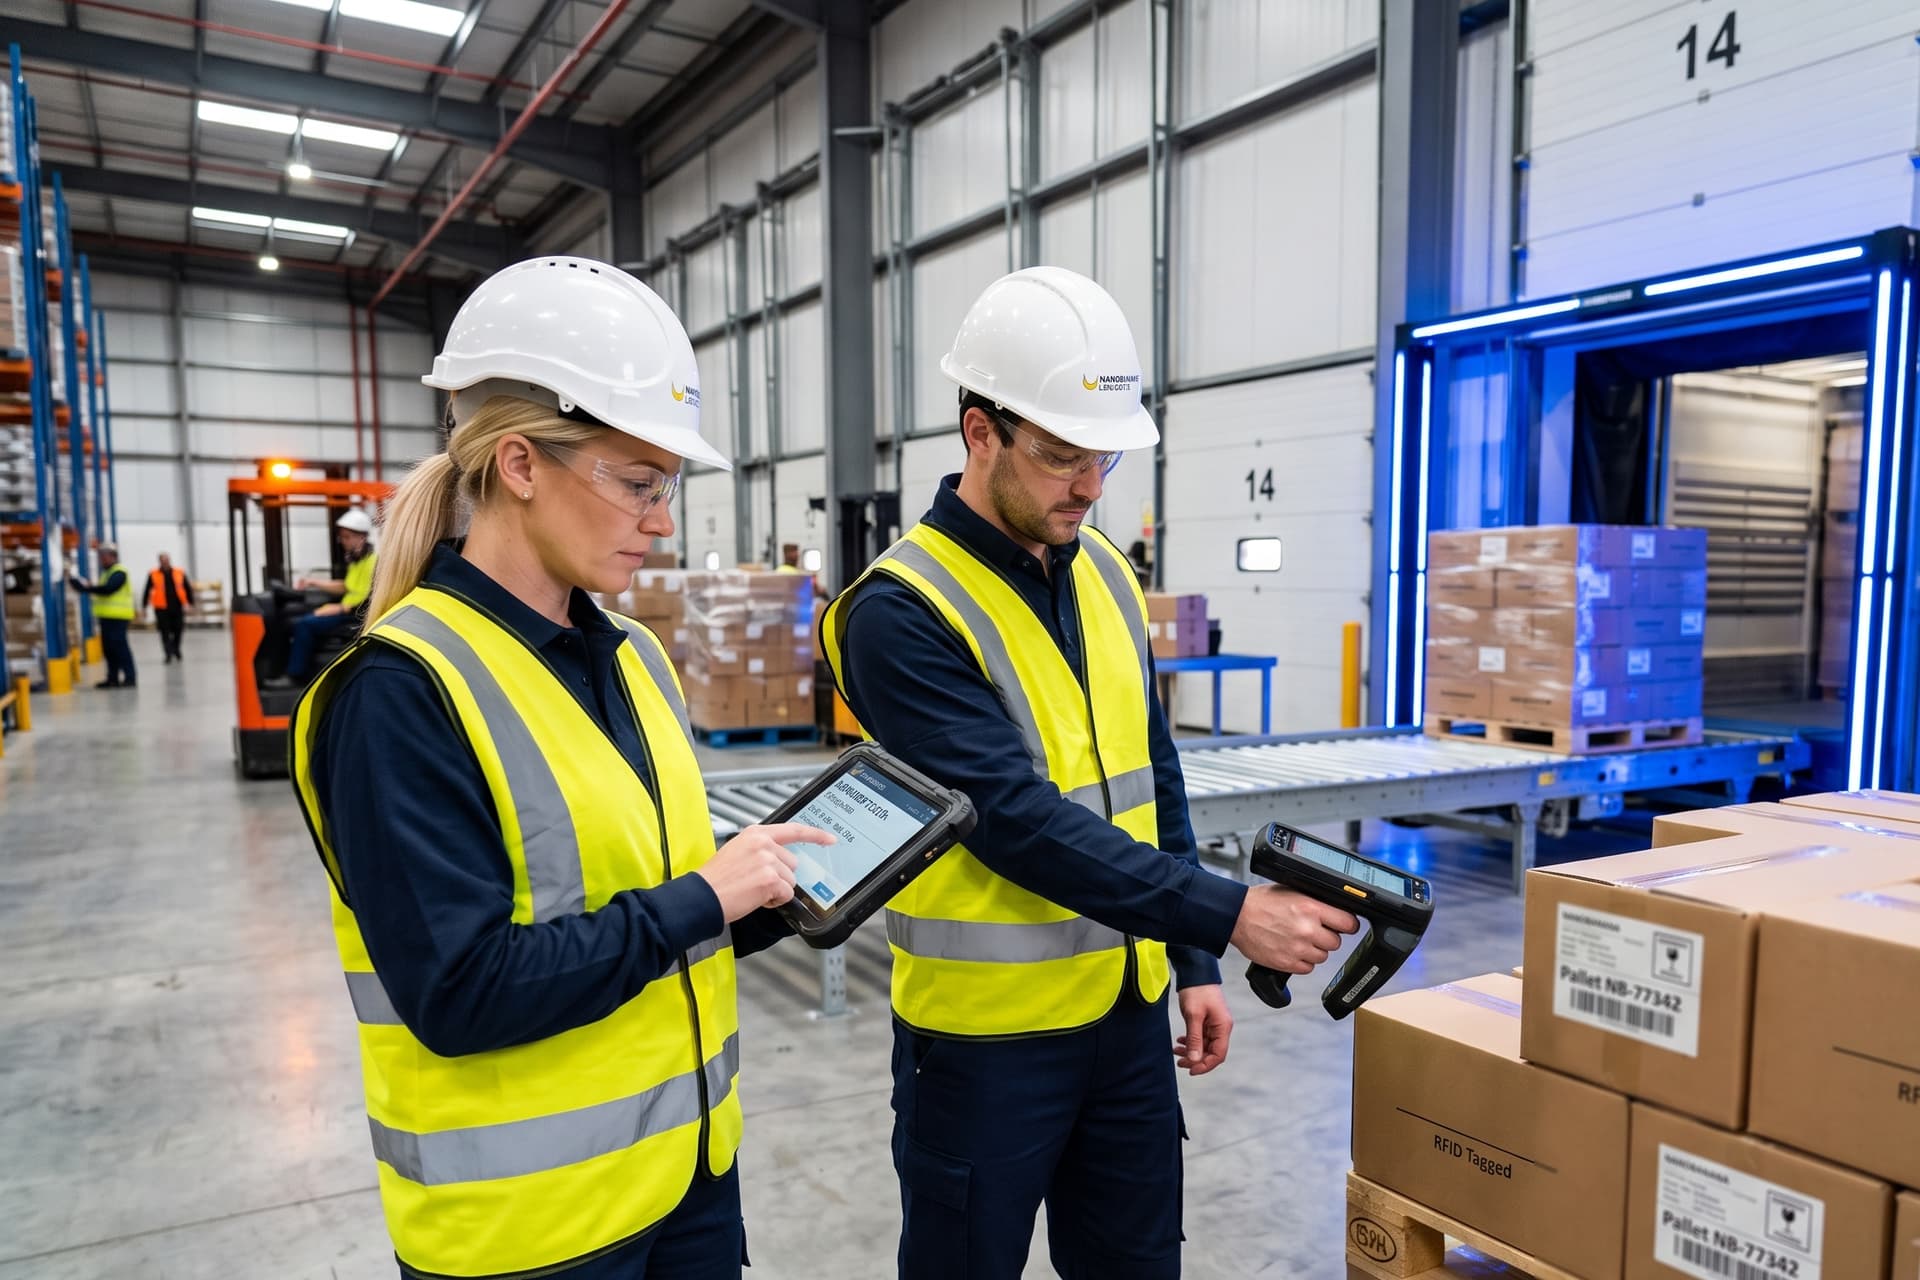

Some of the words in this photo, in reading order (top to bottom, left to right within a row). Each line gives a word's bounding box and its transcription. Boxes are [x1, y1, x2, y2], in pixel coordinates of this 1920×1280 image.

[1677, 10, 1741, 80] 14
[1245, 468, 1275, 502] 14
[1560, 964, 1602, 991] Pallet
[1605, 977, 1682, 1014] NB-77342
[1434, 1134, 1463, 1158] RFID
[1466, 1147, 1512, 1180] Tagged
[1662, 1209, 1709, 1243] Pallet
[1713, 1230, 1800, 1279] NB-77342
